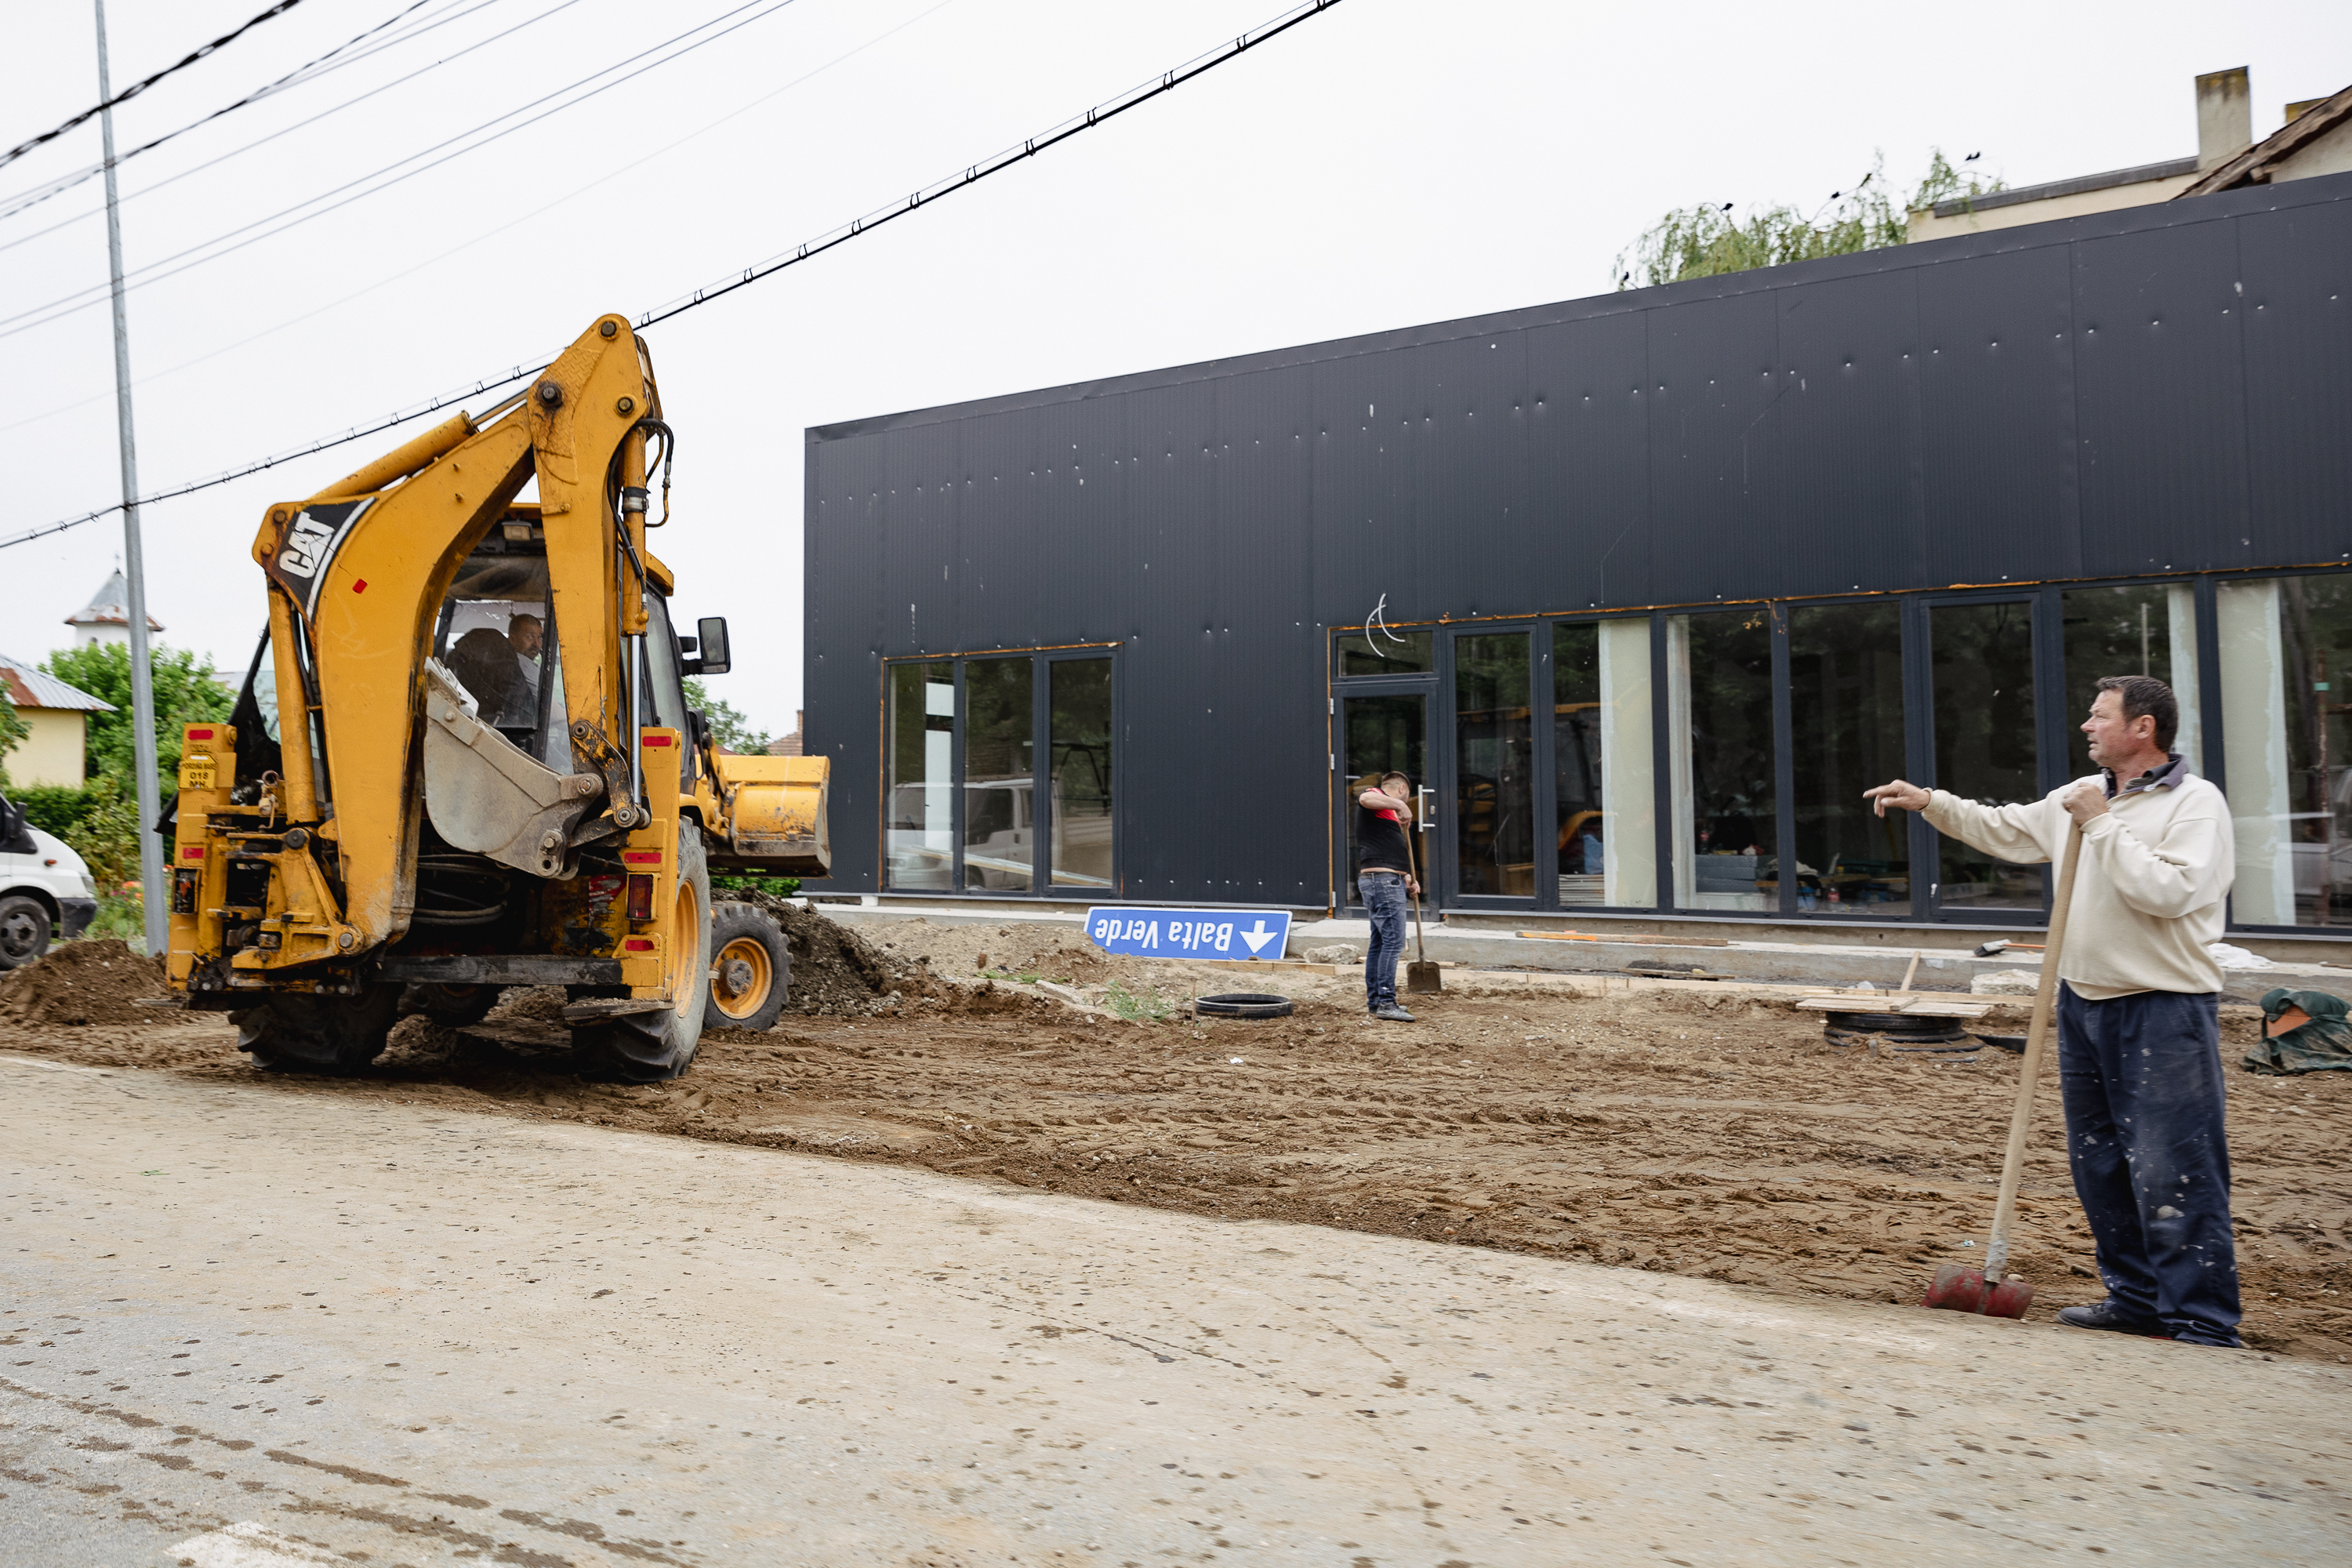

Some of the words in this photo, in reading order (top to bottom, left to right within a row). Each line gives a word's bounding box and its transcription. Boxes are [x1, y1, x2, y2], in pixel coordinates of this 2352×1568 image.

[278, 510, 336, 579] CAT
[1094, 919, 1159, 949] Verde
[1167, 920, 1234, 952] Balta
